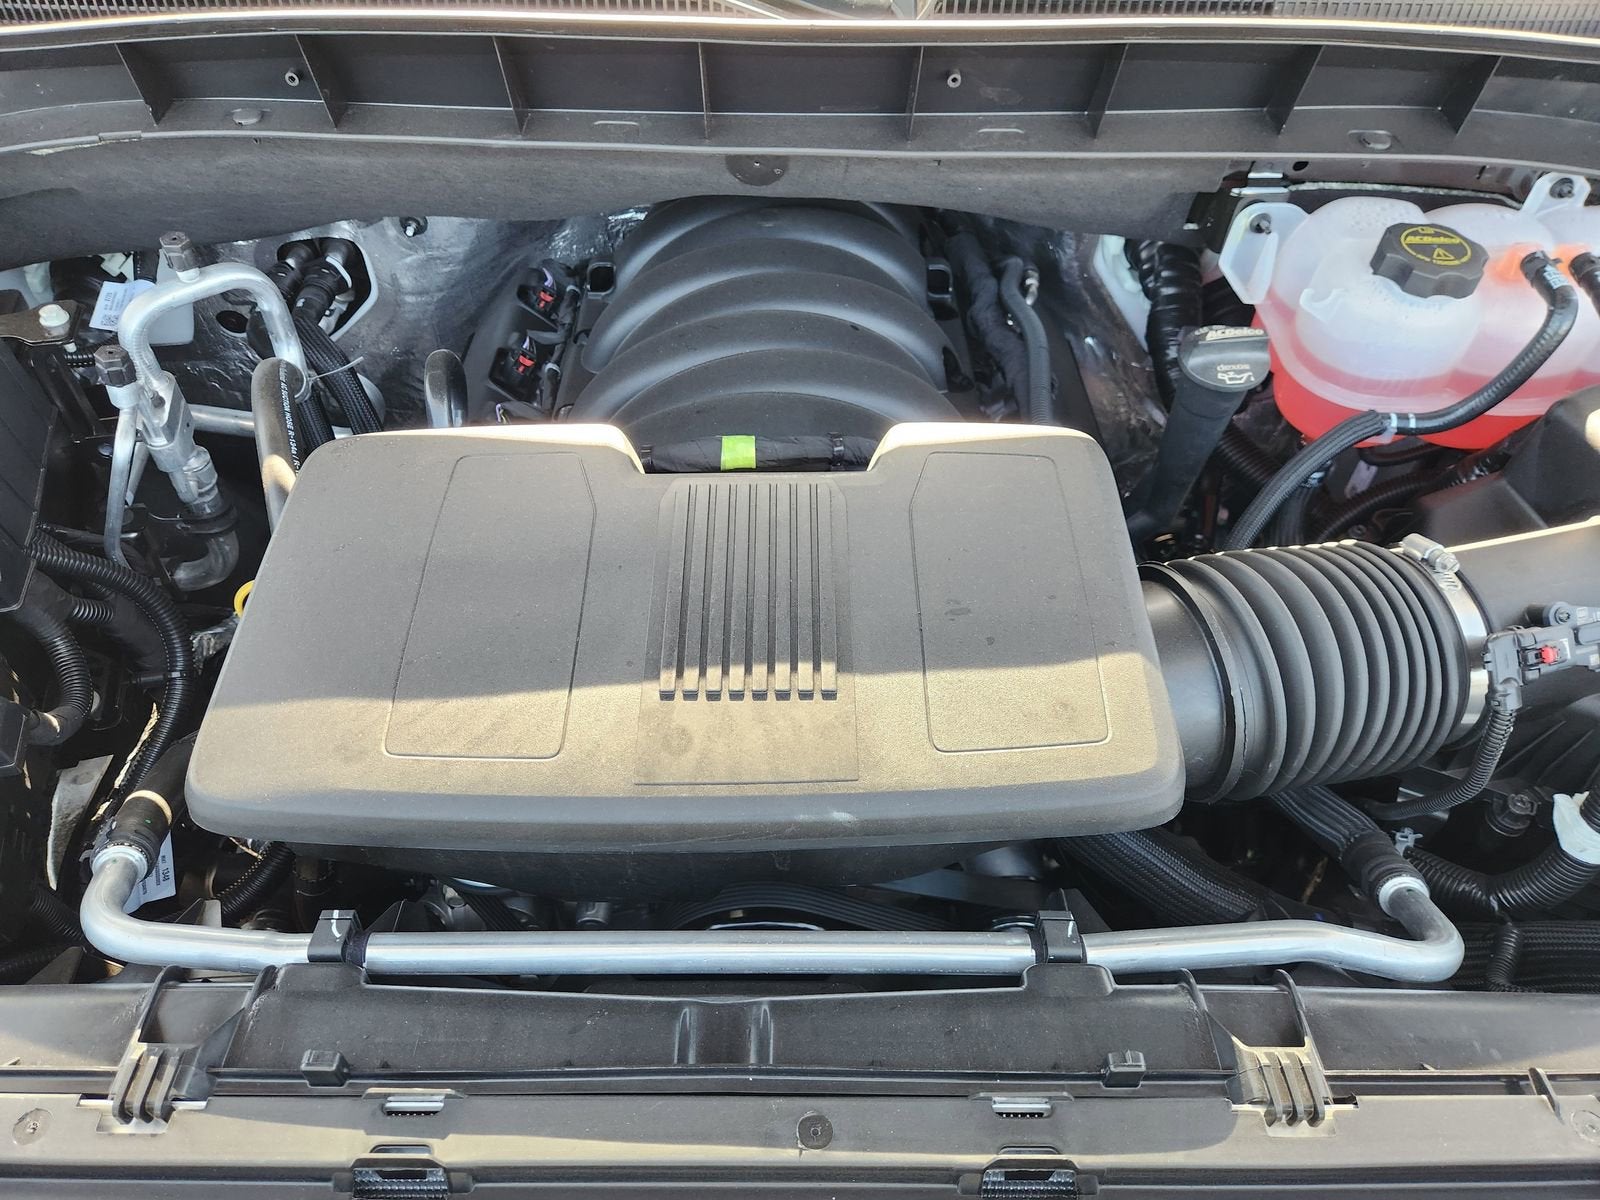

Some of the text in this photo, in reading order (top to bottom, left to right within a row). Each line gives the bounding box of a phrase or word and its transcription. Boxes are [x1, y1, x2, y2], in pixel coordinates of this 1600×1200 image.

[1205, 327, 1264, 341] ACDelco
[285, 411, 294, 430] HOSE
[288, 430, 298, 454] R-134a
